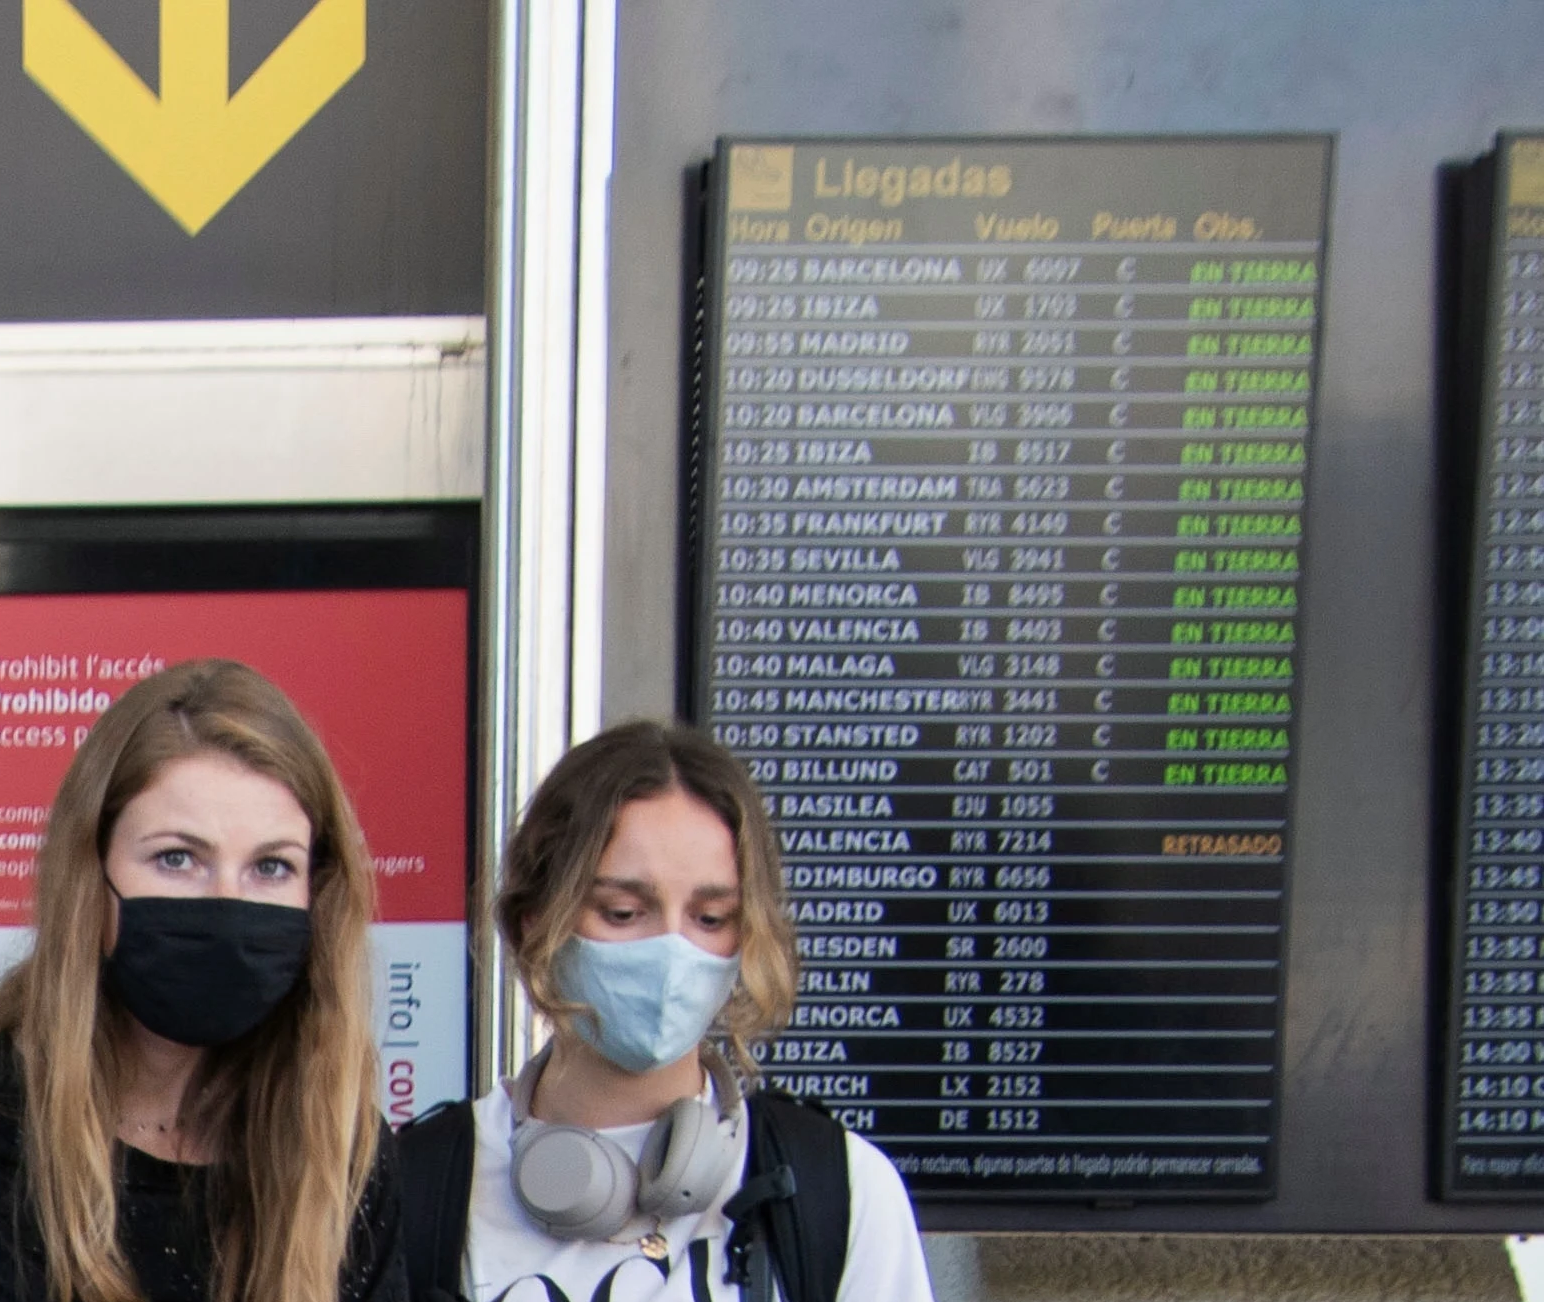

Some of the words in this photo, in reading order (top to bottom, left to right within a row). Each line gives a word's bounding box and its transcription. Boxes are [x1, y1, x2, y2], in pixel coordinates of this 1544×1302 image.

[816, 155, 1012, 208] Llegadas
[728, 214, 790, 242] Hora
[805, 212, 903, 248] Origen
[974, 211, 1060, 241] Vuelo
[1091, 211, 1177, 241] Puerta
[803, 257, 961, 282] BARCELONA
[802, 294, 878, 320] IBIZA
[799, 332, 908, 354] MADRID
[725, 403, 793, 428] 10:20
[797, 403, 954, 428] BARCELONA
[1183, 406, 1216, 430] EN
[1223, 406, 1309, 430] TIERRA
[723, 440, 791, 464] 10:25
[795, 440, 873, 464] IBIZA
[1181, 444, 1215, 466] EN
[1221, 444, 1306, 466] TIERRA
[722, 476, 790, 500] 10:30
[793, 476, 958, 500] AMSTERDAM
[1179, 478, 1213, 502] EN
[1219, 478, 1304, 502] TIERRA
[720, 512, 788, 536] 10:35
[793, 512, 947, 536] FRANKFURT
[1177, 515, 1211, 538] EN
[1217, 515, 1302, 538] TIERRA
[718, 548, 787, 572] 10:35
[790, 548, 901, 572] SEVILLA
[1176, 551, 1210, 575] EN
[1215, 551, 1299, 575] TIERRA
[717, 583, 785, 607] 10:40
[789, 583, 919, 607] MENORCA
[1174, 586, 1208, 610] EN
[1213, 586, 1297, 610] TIERRA
[715, 619, 783, 642] 10:40
[787, 619, 919, 642] VALENCIA
[1172, 622, 1206, 644] EN
[1211, 622, 1295, 644] TIERRA
[714, 654, 782, 676] 10:40
[786, 654, 895, 676] MALAGA
[1170, 658, 1205, 679] EN
[1209, 658, 1293, 679] TIERRA
[713, 689, 780, 712] 10:45
[785, 689, 959, 712] MANCHESTER
[1168, 692, 1203, 714] EN
[1207, 692, 1291, 714] TIERRA
[712, 724, 779, 746] 10:50
[783, 724, 918, 746] STANSTED
[1003, 724, 1057, 746] 1202
[1167, 728, 1201, 749] EN
[1205, 728, 1289, 749] TIERRA
[782, 760, 897, 782] BILLUND
[953, 760, 990, 782] CAT
[1008, 760, 1053, 782] 501
[1165, 764, 1199, 785] EN
[1203, 764, 1287, 785] TIERRA
[781, 796, 892, 818] BASILEA
[952, 796, 987, 818] EJU
[999, 796, 1053, 818] 1055
[780, 830, 910, 852] VALENCIA
[951, 830, 987, 852] RYR
[998, 830, 1051, 852] 7214
[1162, 835, 1281, 856] RETRASADO
[949, 866, 985, 888] RYR
[947, 901, 977, 922] UX
[993, 901, 1049, 922] 6013
[796, 936, 896, 958] RESDEN
[945, 936, 975, 958] SR
[992, 936, 1047, 958] 2600
[798, 970, 870, 992] ERLIN
[944, 970, 980, 992] RYR
[999, 970, 1045, 992] 278
[389, 961, 421, 1030] info
[789, 1006, 900, 1028] ENORCA
[942, 1006, 973, 1028] UX
[988, 1006, 1045, 1028] 4532
[772, 1041, 846, 1062] IBIZA
[942, 1041, 969, 1062] IB
[987, 1041, 1043, 1062] 8527
[940, 1076, 970, 1096] LX
[987, 1076, 1041, 1096] 2152
[1460, 1076, 1529, 1098] 14:10
[939, 1108, 968, 1130] DE
[987, 1108, 1039, 1130] 1512
[1458, 1110, 1529, 1131] 14:10
